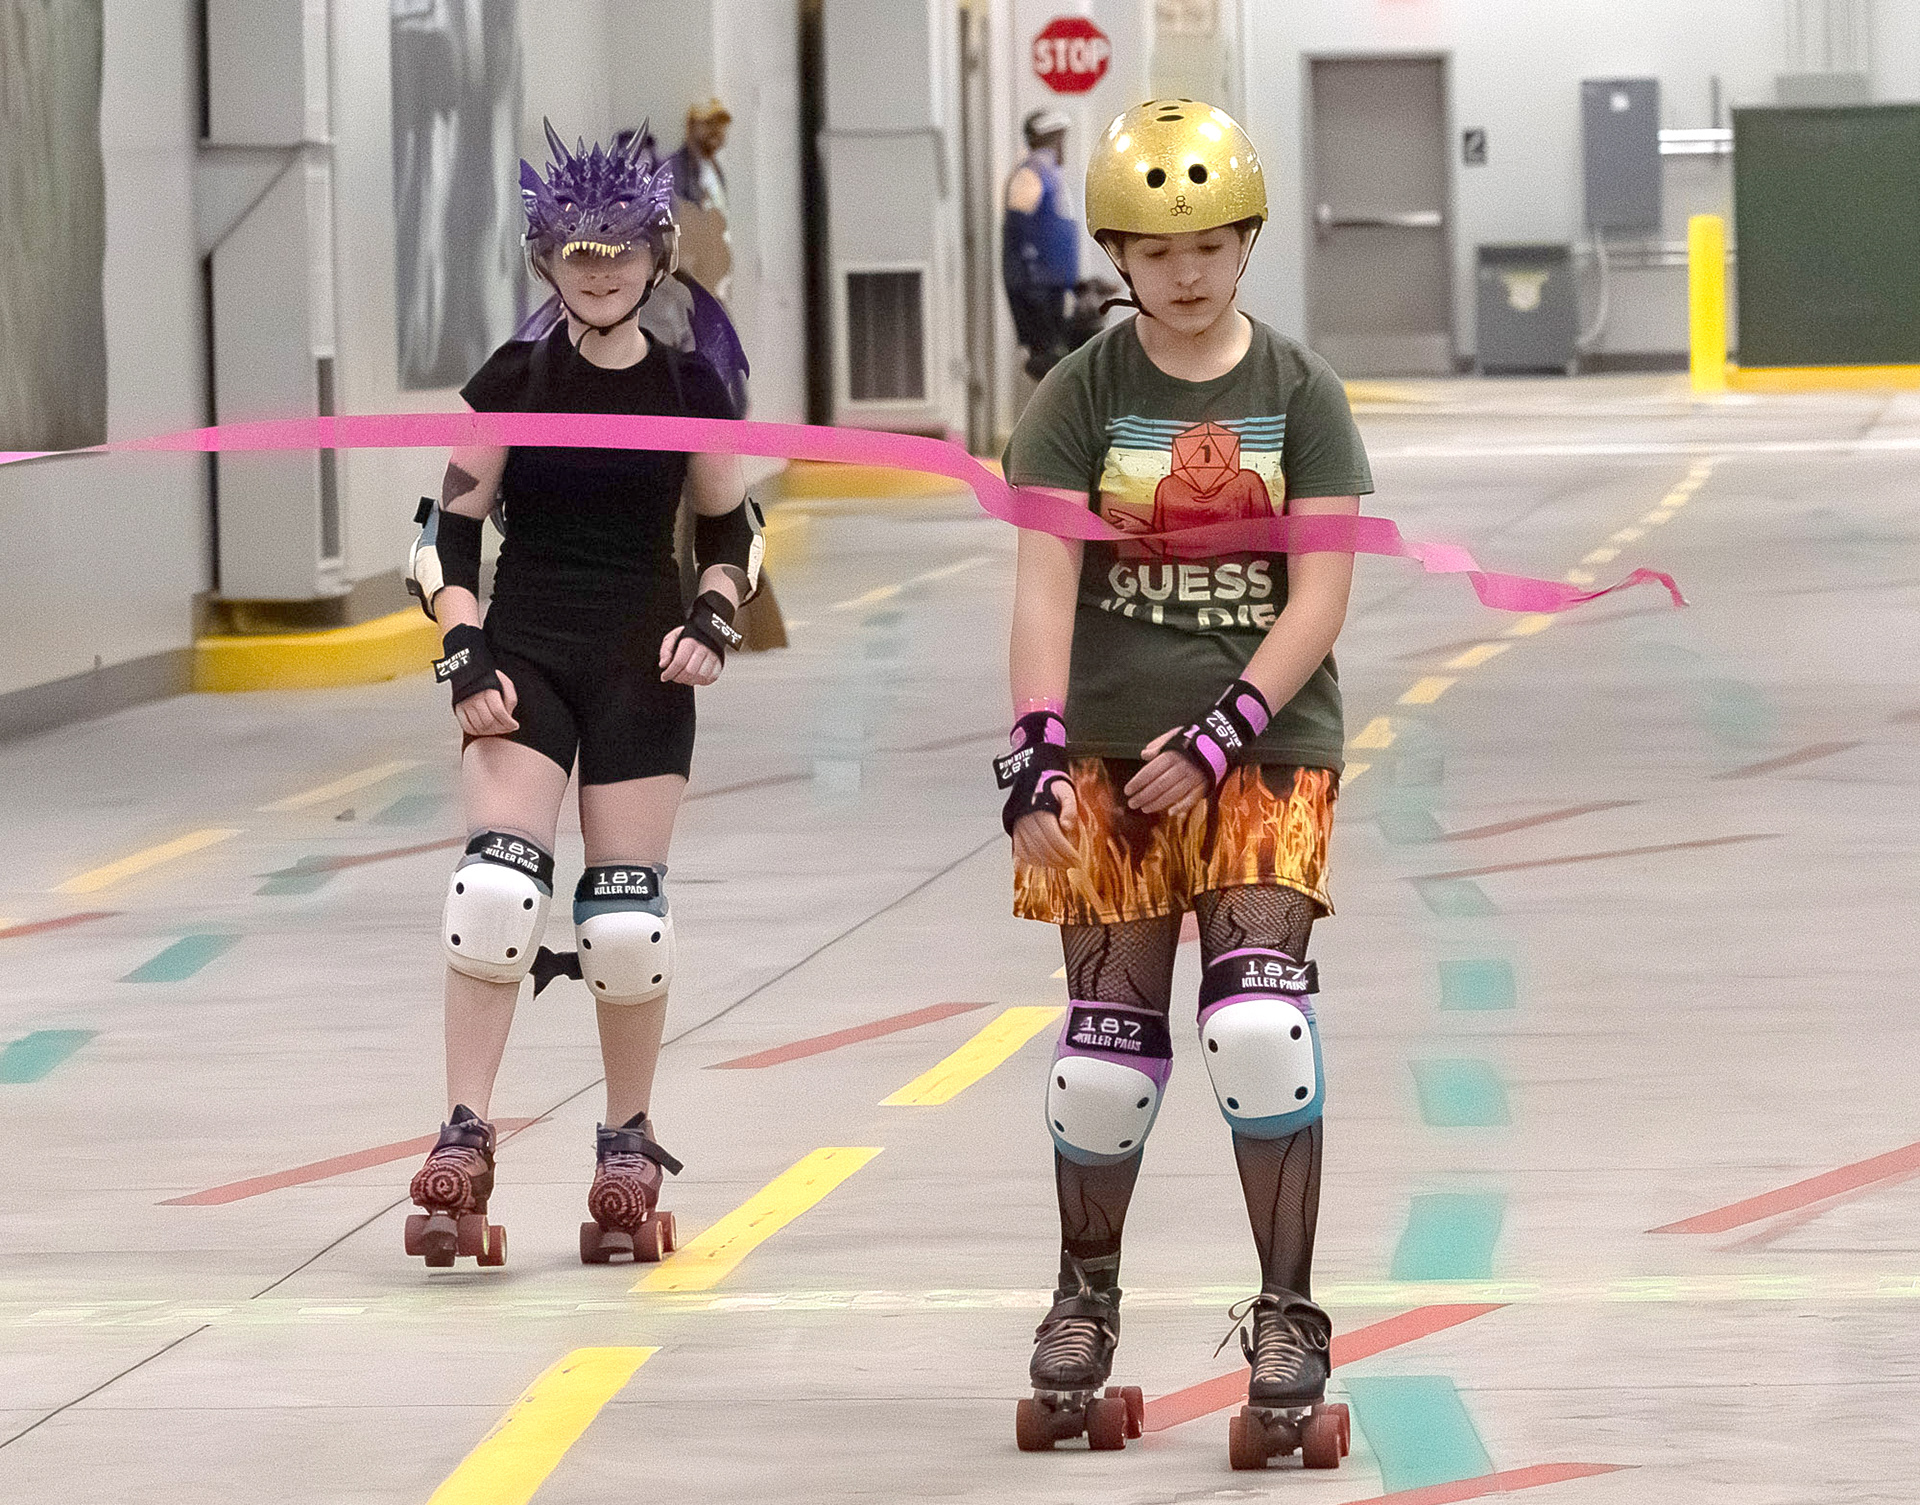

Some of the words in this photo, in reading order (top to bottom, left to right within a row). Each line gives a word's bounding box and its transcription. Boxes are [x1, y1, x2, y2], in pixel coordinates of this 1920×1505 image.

[1034, 37, 1111, 74] STOP
[1200, 443, 1211, 464] 1
[1108, 560, 1272, 602] GUESS
[438, 654, 469, 677] 187
[1205, 713, 1236, 749] 187
[1002, 756, 1031, 780] 187
[485, 847, 517, 863] KILLER
[517, 857, 540, 873] PADS
[493, 838, 540, 861] 187
[597, 871, 647, 885] 187
[594, 885, 623, 896] KILLER
[624, 885, 649, 895] PADS
[1246, 960, 1310, 980] 187
[1242, 976, 1277, 989] KILLER
[1080, 1015, 1142, 1038] 187
